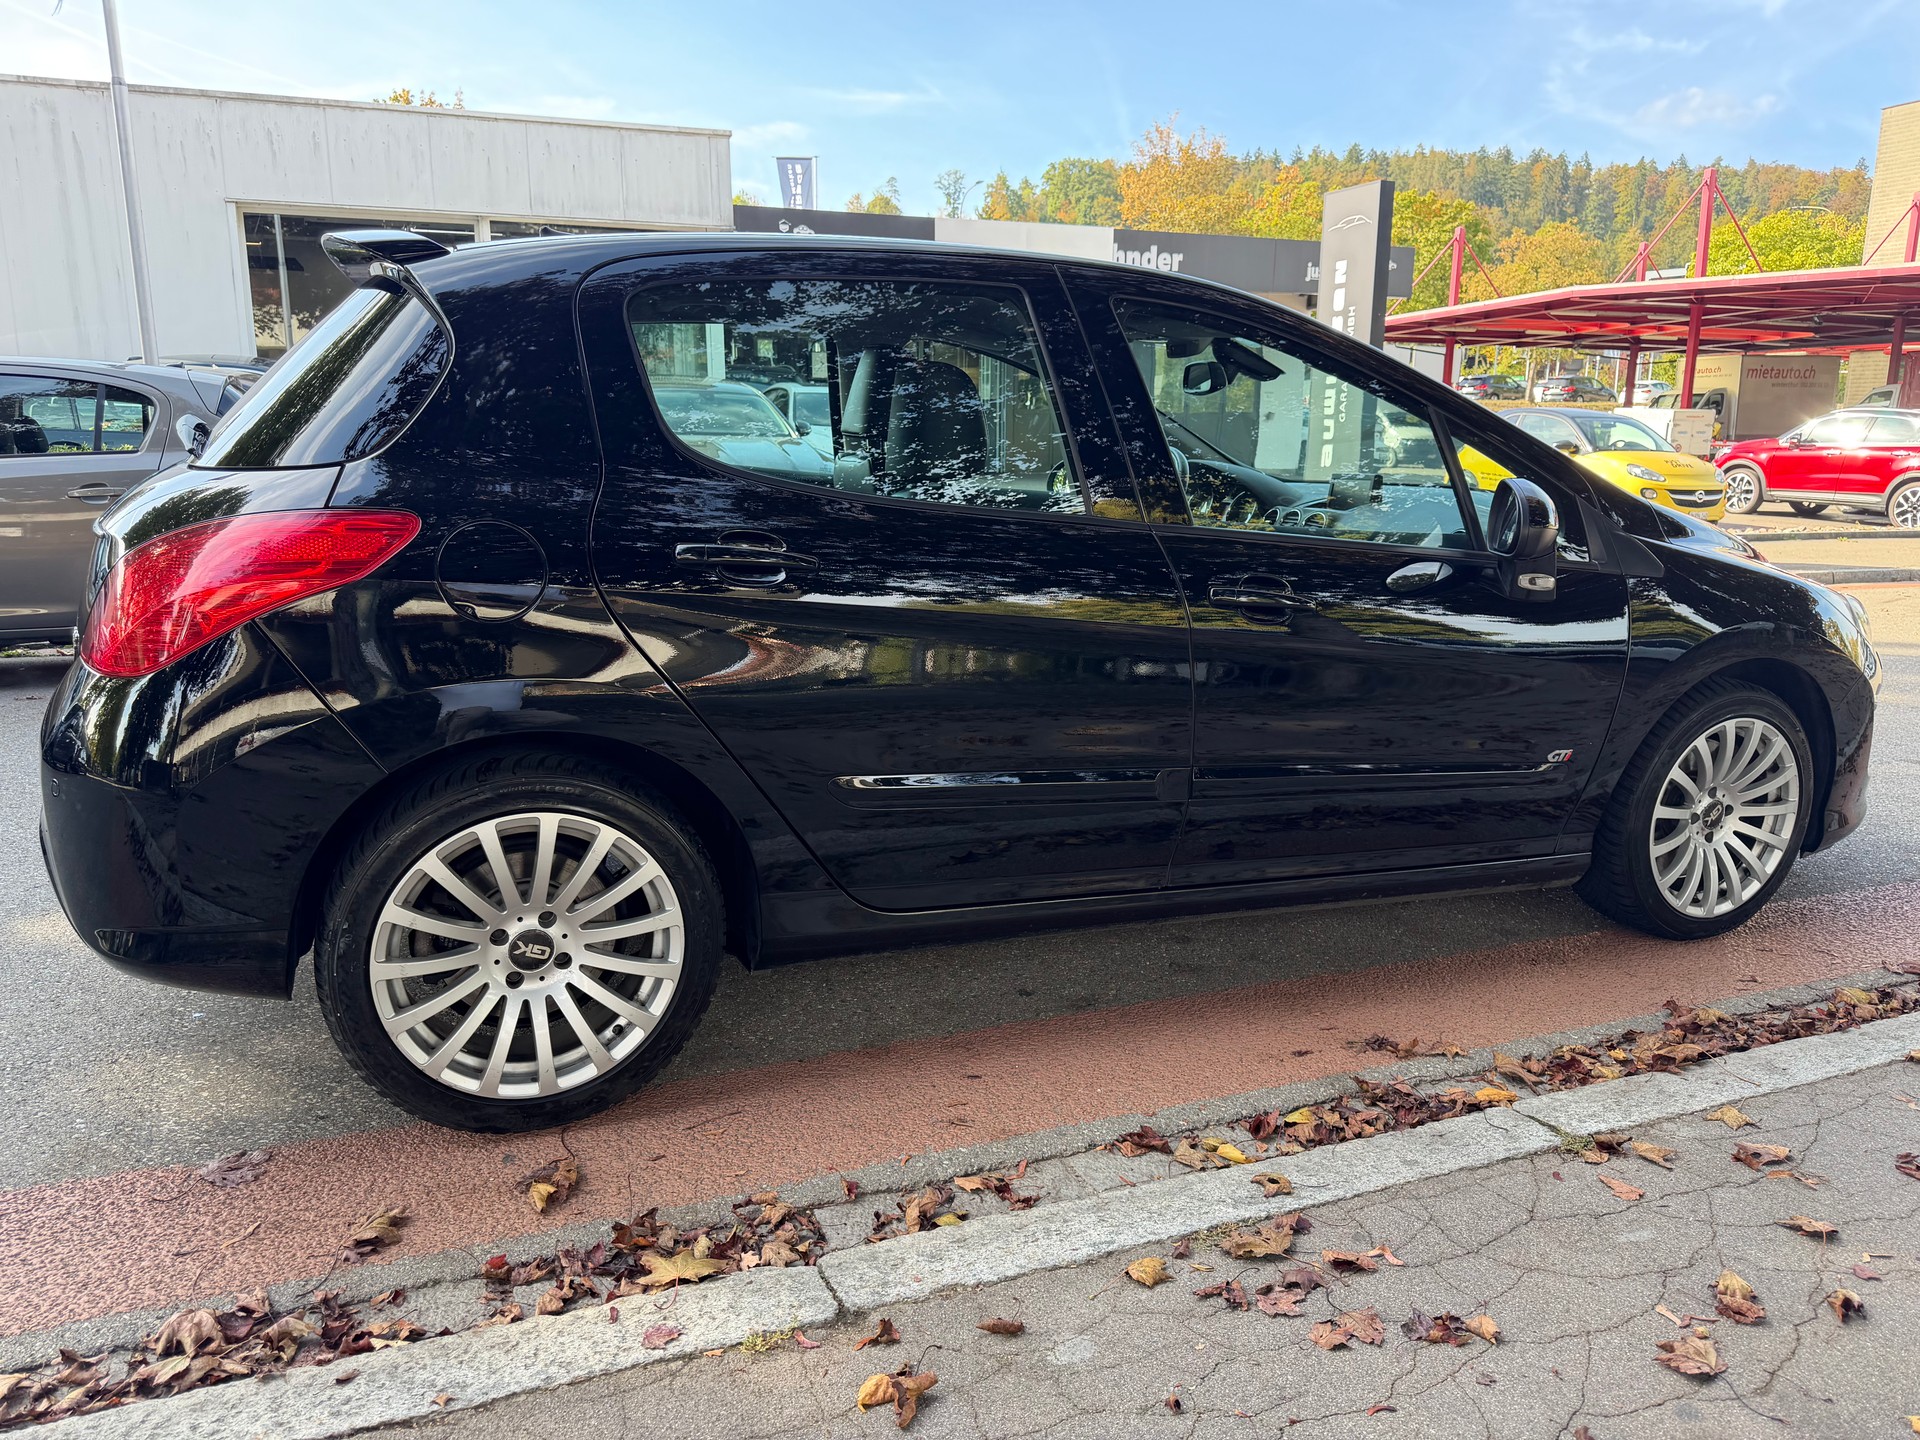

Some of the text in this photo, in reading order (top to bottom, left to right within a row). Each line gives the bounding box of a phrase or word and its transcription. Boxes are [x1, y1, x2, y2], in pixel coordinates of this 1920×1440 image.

[1113, 243, 1183, 271] hnder
[1746, 364, 1816, 380] mietauto.ch
[512, 940, 551, 960] GK
